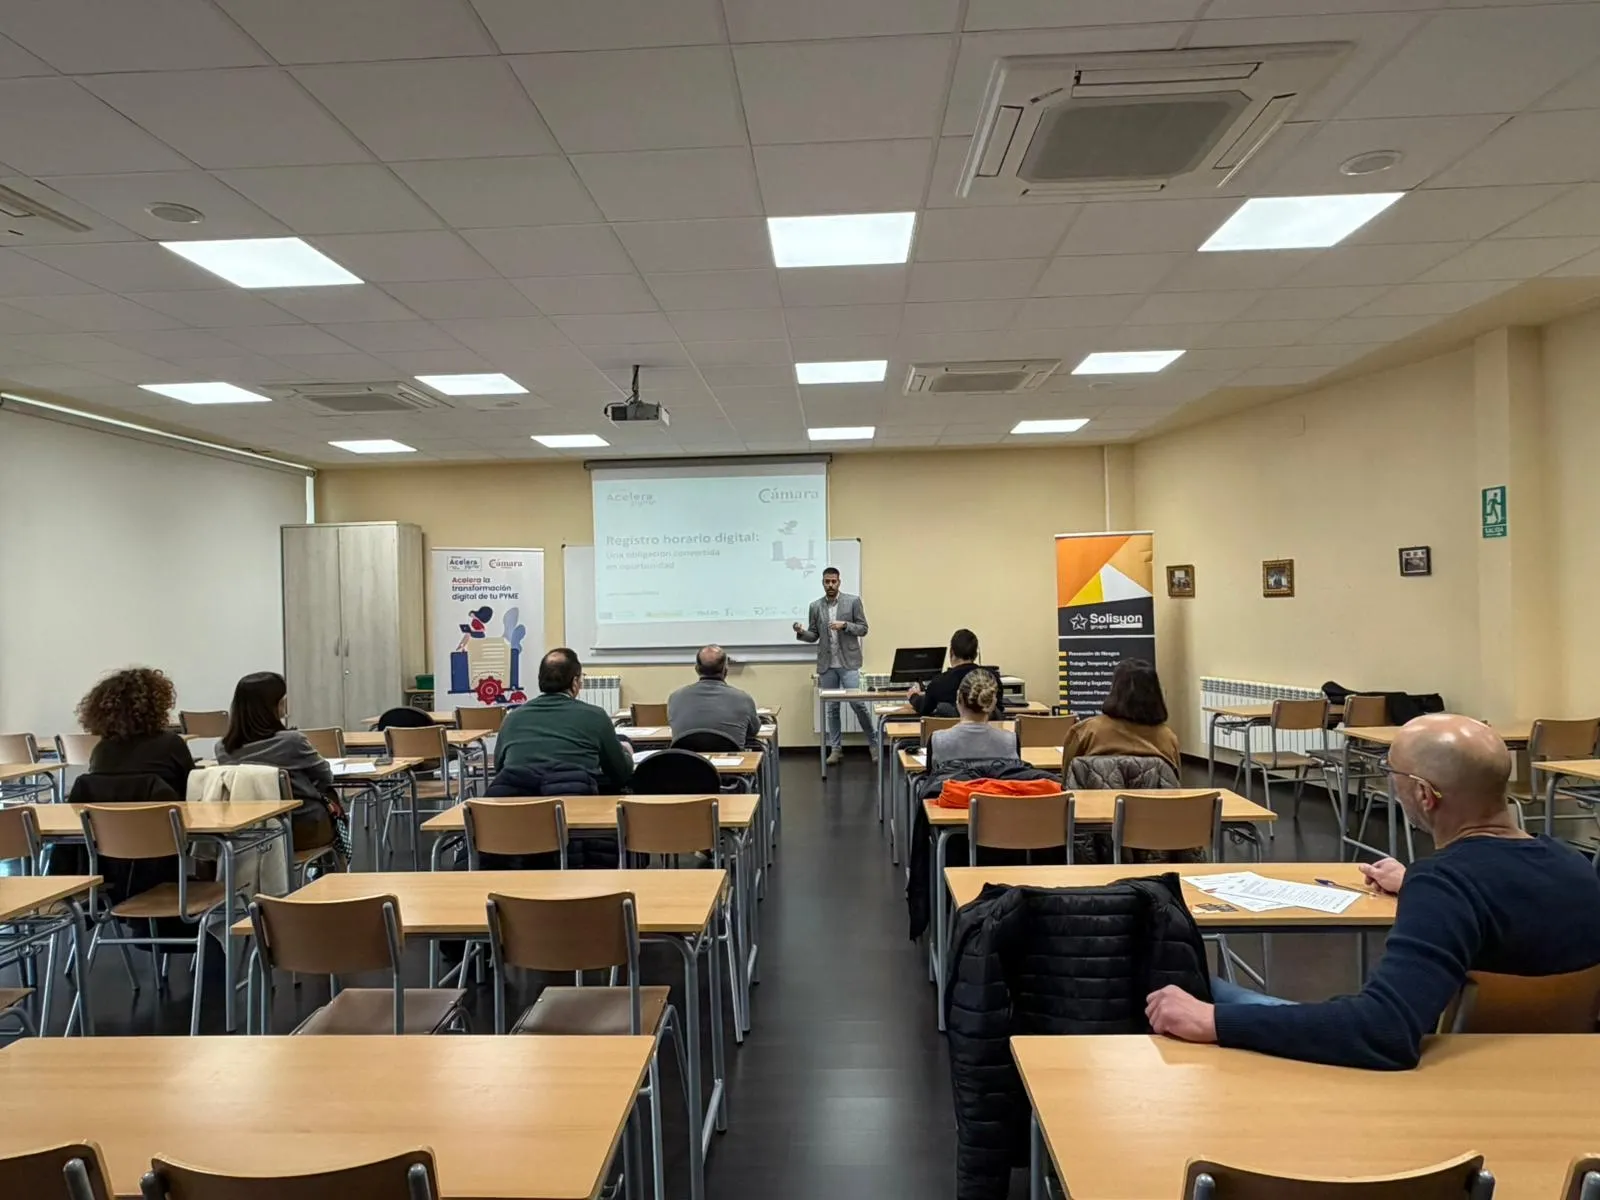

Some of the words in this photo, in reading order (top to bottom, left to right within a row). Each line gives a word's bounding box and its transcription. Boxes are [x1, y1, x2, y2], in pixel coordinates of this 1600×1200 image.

[606, 492, 653, 501] Acelera
[758, 487, 819, 503] Cámara
[606, 535, 660, 547] Registro
[663, 534, 712, 545] horario
[714, 532, 760, 545] digital:
[673, 548, 720, 557] convertida
[488, 559, 523, 569] Cámara
[452, 593, 477, 602] digital
[1090, 613, 1143, 625] Solisyon
